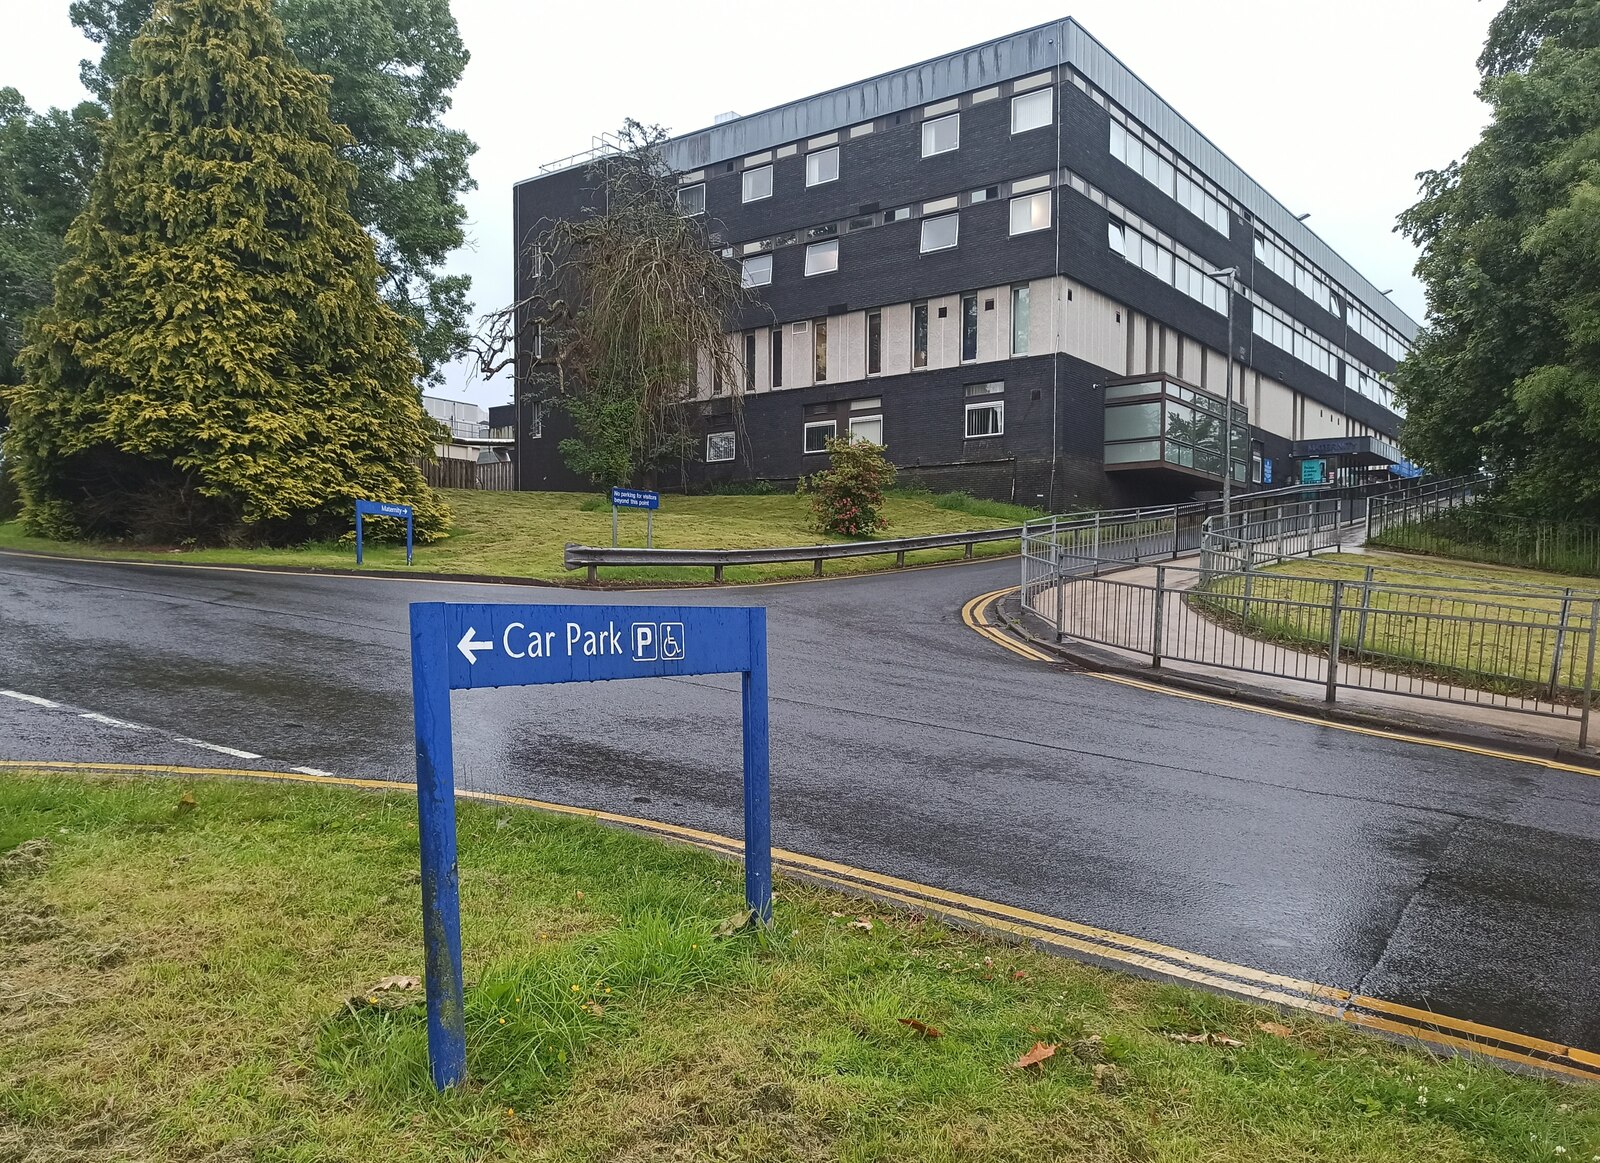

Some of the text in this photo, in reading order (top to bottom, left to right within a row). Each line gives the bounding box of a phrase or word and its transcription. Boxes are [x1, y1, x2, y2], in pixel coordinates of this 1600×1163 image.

[621, 491, 636, 499] parking
[381, 505, 402, 515] Maternity
[503, 621, 652, 659] Car Park P
